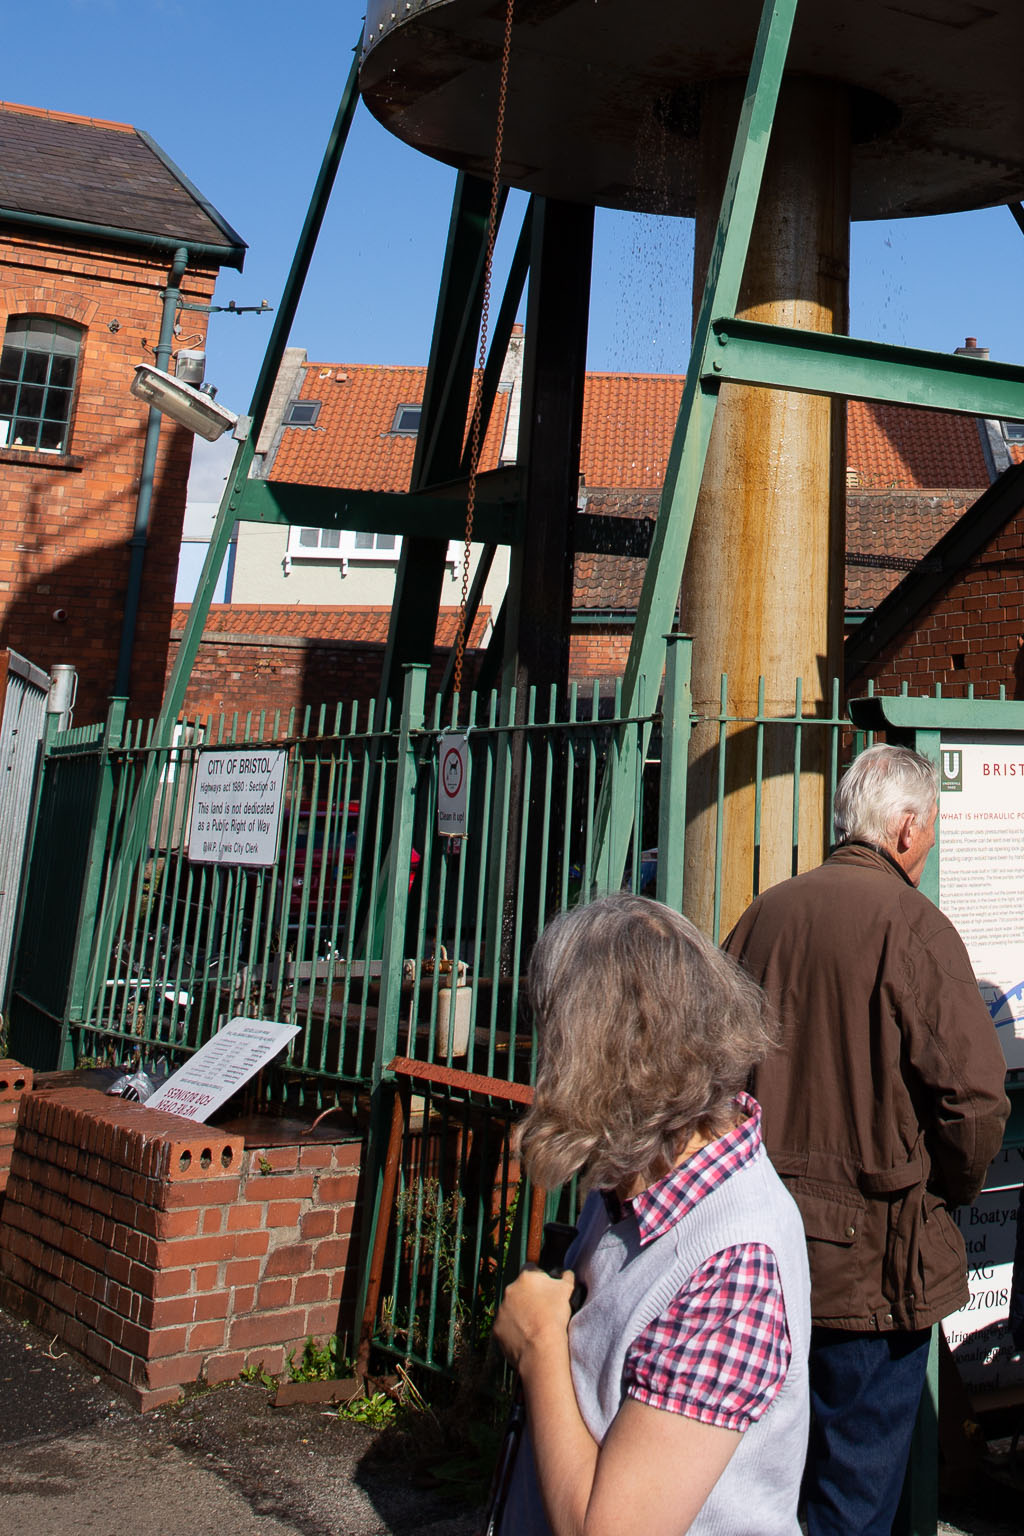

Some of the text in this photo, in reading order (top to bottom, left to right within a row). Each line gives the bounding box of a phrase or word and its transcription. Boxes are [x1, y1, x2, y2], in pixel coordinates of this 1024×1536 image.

[208, 758, 271, 775] CITY OF BRISTOL
[200, 782, 221, 794] Highways
[249, 781, 268, 792] Section
[270, 781, 276, 791] 31
[198, 802, 275, 814] This land is not dedicated
[440, 812, 452, 822] Clean
[453, 812, 456, 822] it
[198, 819, 270, 834] as a Public Right of Way
[234, 842, 244, 855] City
[246, 842, 258, 853] Clerk
[164, 1087, 214, 1106] FOR BUSINESS
